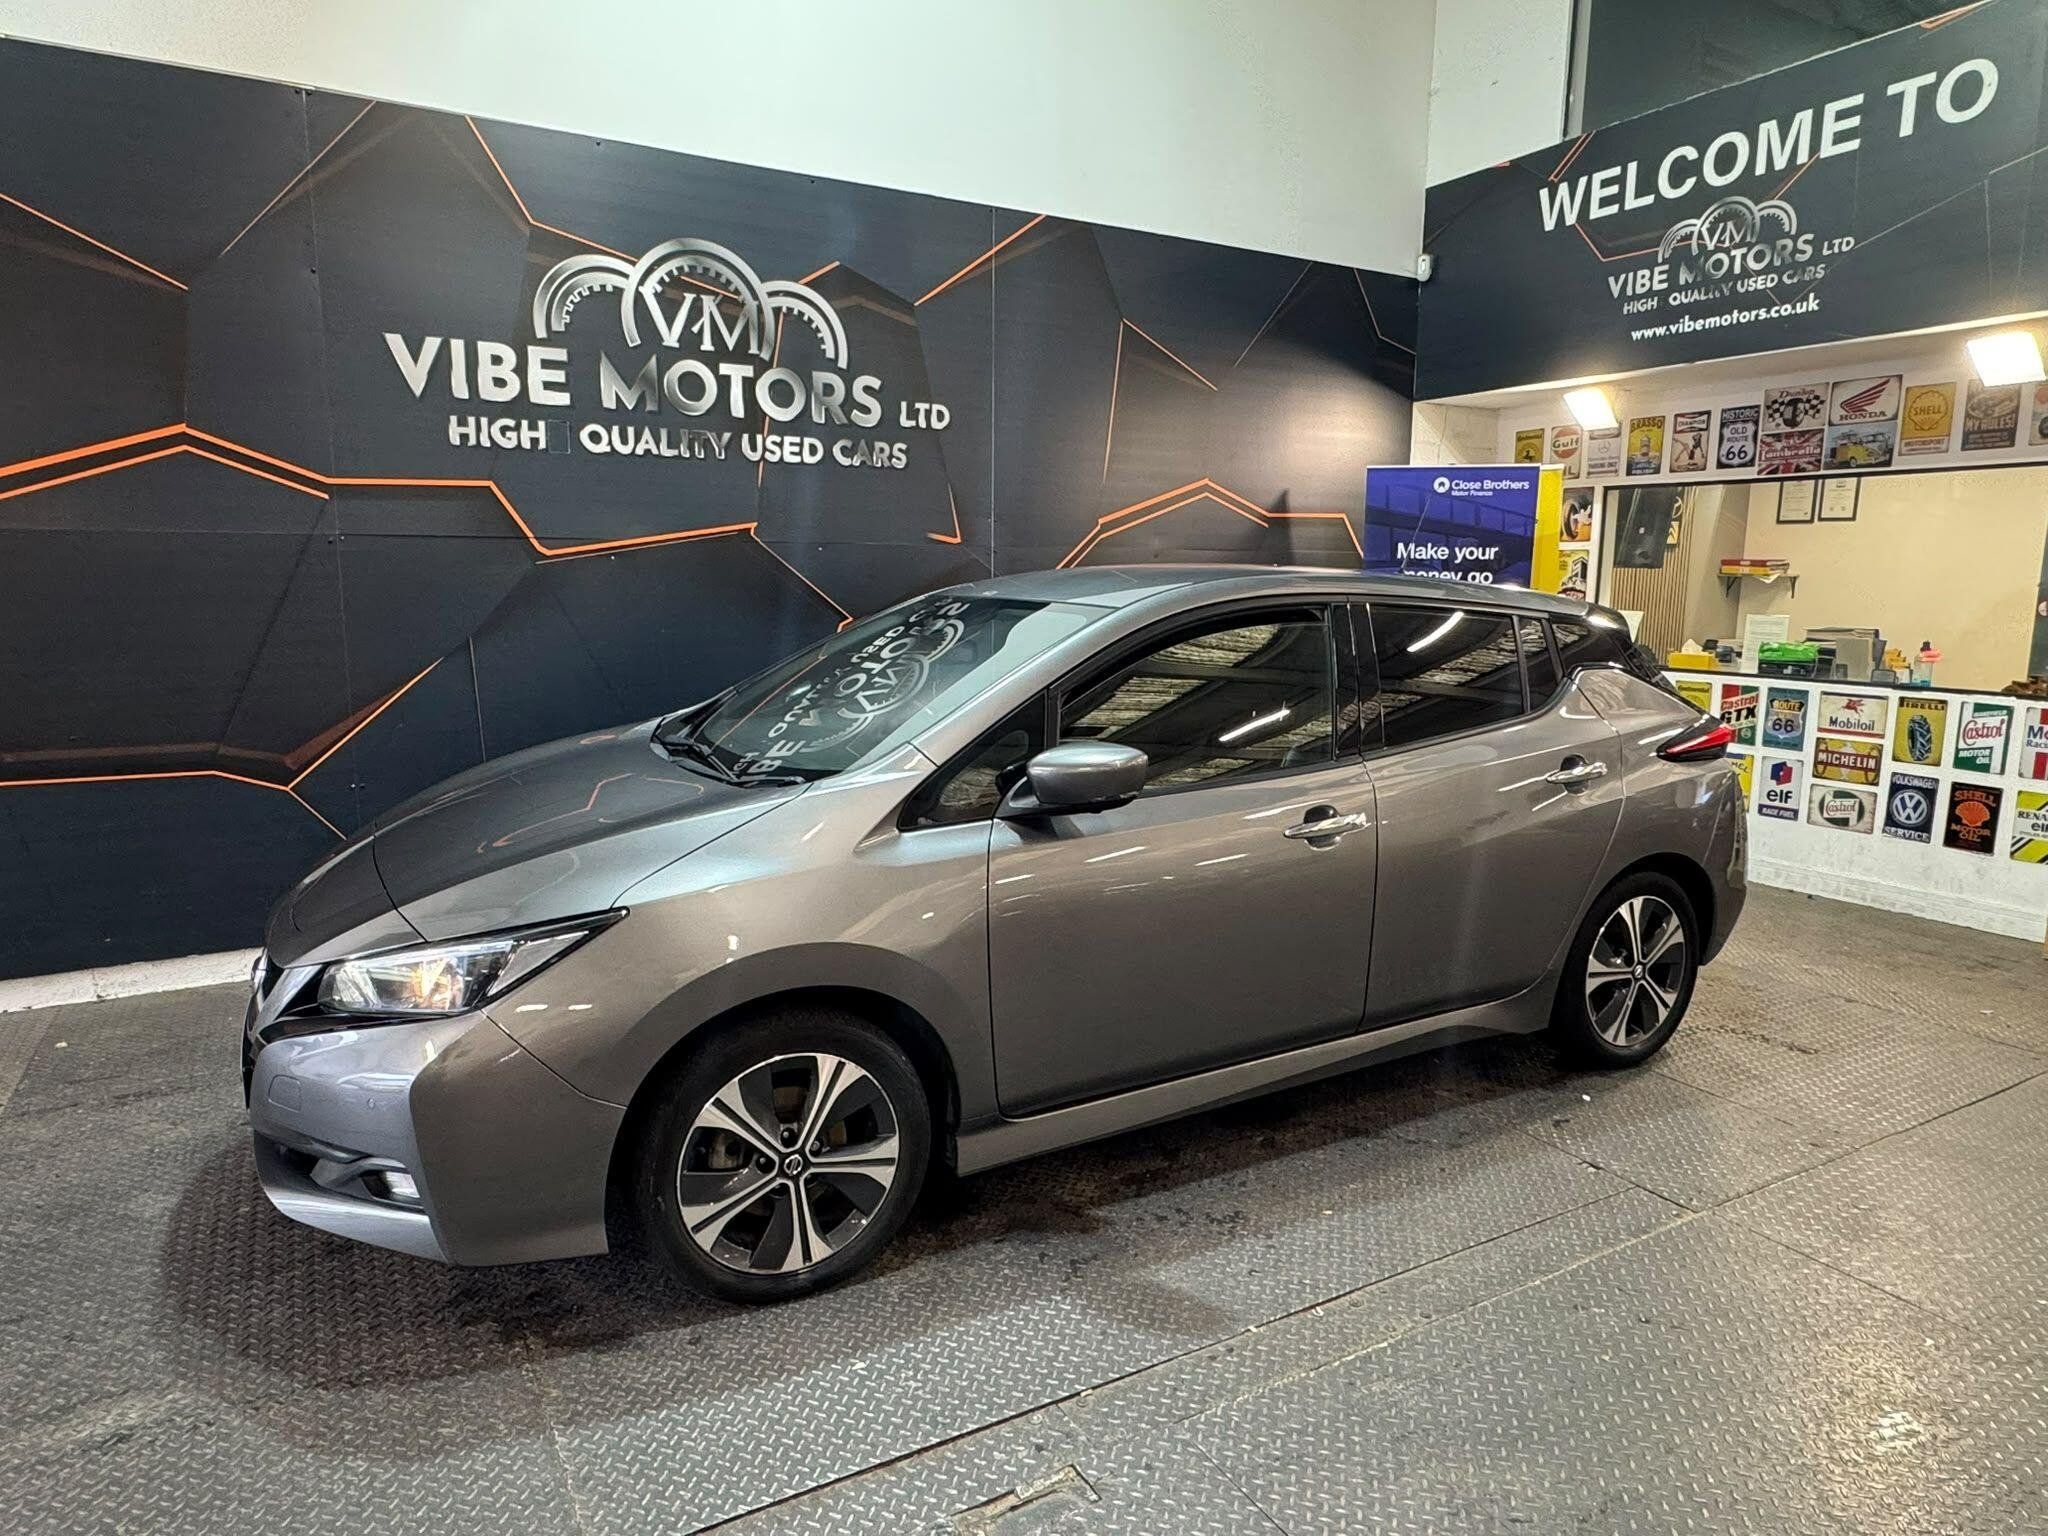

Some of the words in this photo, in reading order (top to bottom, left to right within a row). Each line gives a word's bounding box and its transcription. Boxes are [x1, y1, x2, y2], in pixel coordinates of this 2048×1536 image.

[1539, 93, 1865, 231] WELCOME
[1886, 58, 1999, 138] TO
[1608, 264, 1669, 299] VIBE
[1679, 233, 1814, 285] MOTORS
[1822, 236, 1855, 256] LTD
[1623, 297, 1658, 315] HIGH
[1669, 282, 1733, 307] QUALITY
[1736, 273, 1778, 293] USED
[1782, 264, 1826, 285] CARS
[638, 284, 760, 354] VM
[1631, 293, 1820, 341] www.vibemotors.co.uk
[382, 332, 572, 406] VIBE
[600, 350, 882, 428] MOTORS
[899, 401, 951, 430] LTD
[1722, 408, 1759, 420] HISTORIC
[1839, 411, 1887, 420] HONDA
[1913, 405, 1941, 416] SHELL
[1630, 420, 1663, 433] BRASSO
[1730, 426, 1747, 435] OLD
[449, 415, 547, 450] HIGH
[579, 423, 732, 460] QUALITY
[741, 433, 824, 464] USED
[832, 439, 908, 468] CARS
[1552, 438, 1579, 449] Gulf
[1725, 445, 1748, 461] 66
[1564, 466, 1576, 477] IL
[1451, 480, 1481, 491] Close
[1483, 479, 1530, 491] Brothers
[1397, 542, 1449, 560] Make
[1454, 544, 1499, 564] your
[1721, 693, 1759, 710] Castrol
[1774, 700, 1800, 711] ROUTE
[1720, 705, 1757, 724] GTX
[1772, 718, 1795, 733] 66
[1829, 716, 1875, 731] Mobiloil
[1962, 718, 2006, 746] Castrol
[1818, 751, 1876, 769] MICHELIN
[1958, 749, 1991, 758] MOTOR
[1891, 774, 1938, 790] VOLKSWAGEN
[1767, 789, 1793, 804] elf
[1955, 790, 1997, 807] SHELL
[1762, 807, 1779, 817] RACE
[1780, 809, 1796, 819] FUEL
[1825, 800, 1857, 816] Castrol
[1883, 827, 1929, 842] SERVICE
[1951, 824, 1991, 837] MOTOR
[1960, 830, 1981, 842] OIL
